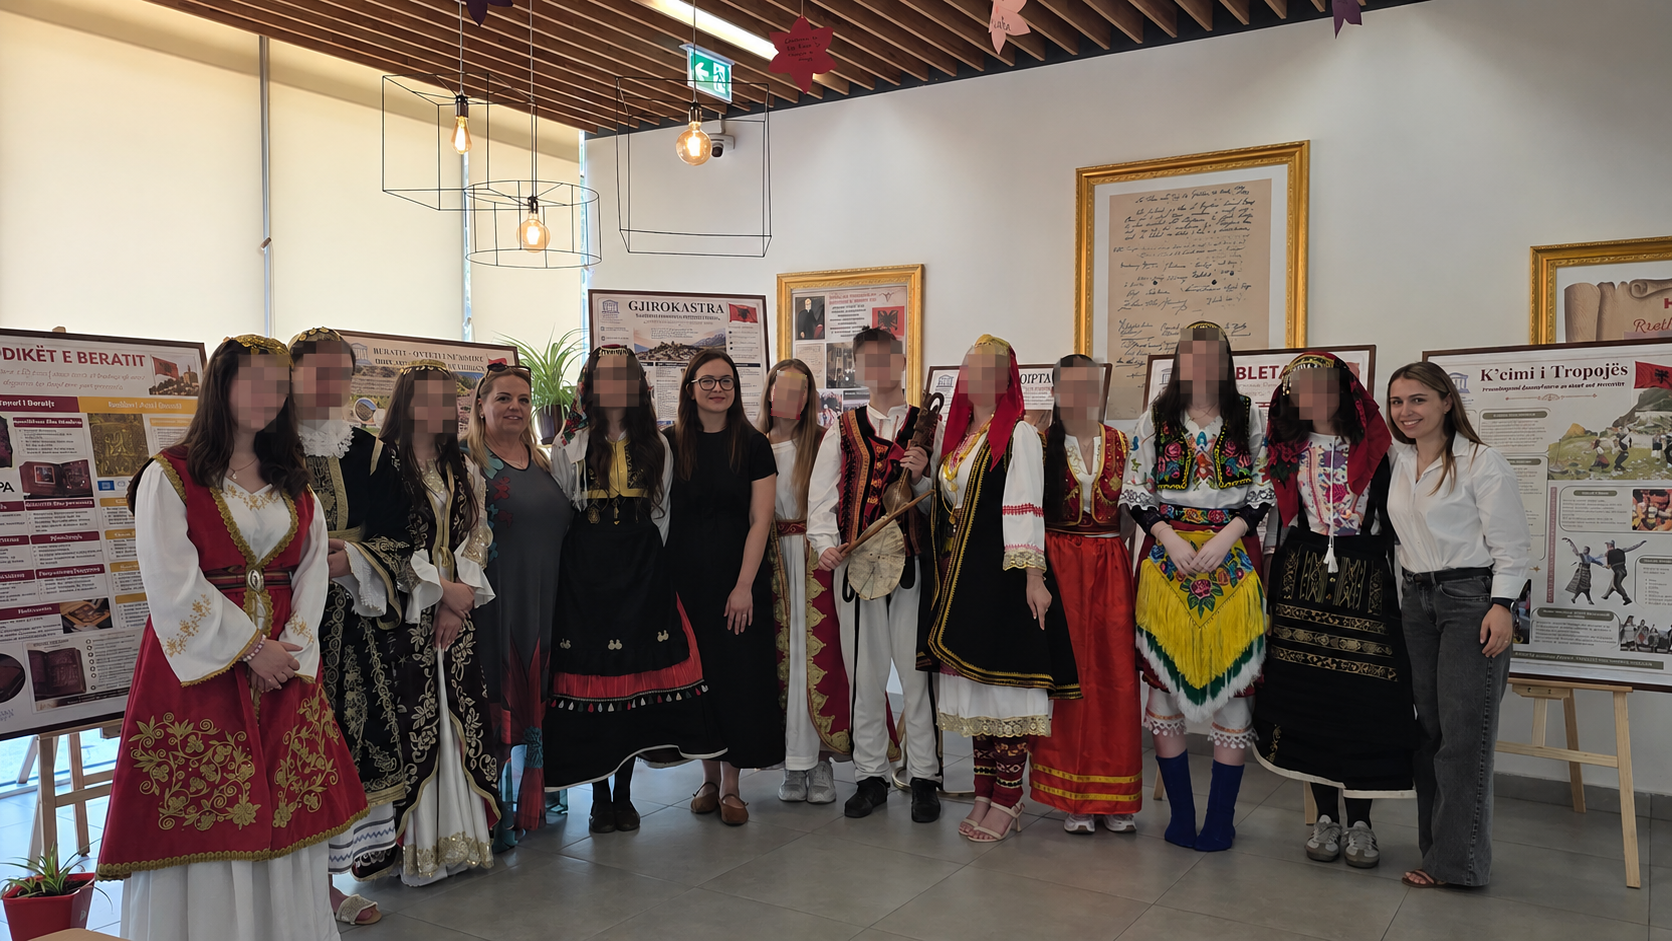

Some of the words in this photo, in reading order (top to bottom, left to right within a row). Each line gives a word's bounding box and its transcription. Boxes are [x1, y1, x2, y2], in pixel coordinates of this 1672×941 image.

[628, 300, 725, 314] GJIROKASTRA
[0, 345, 57, 362] DIKËT
[62, 350, 73, 364] E
[77, 351, 146, 367] BERATIT
[1540, 366, 1546, 379] i
[1550, 363, 1629, 381] Tropojës
